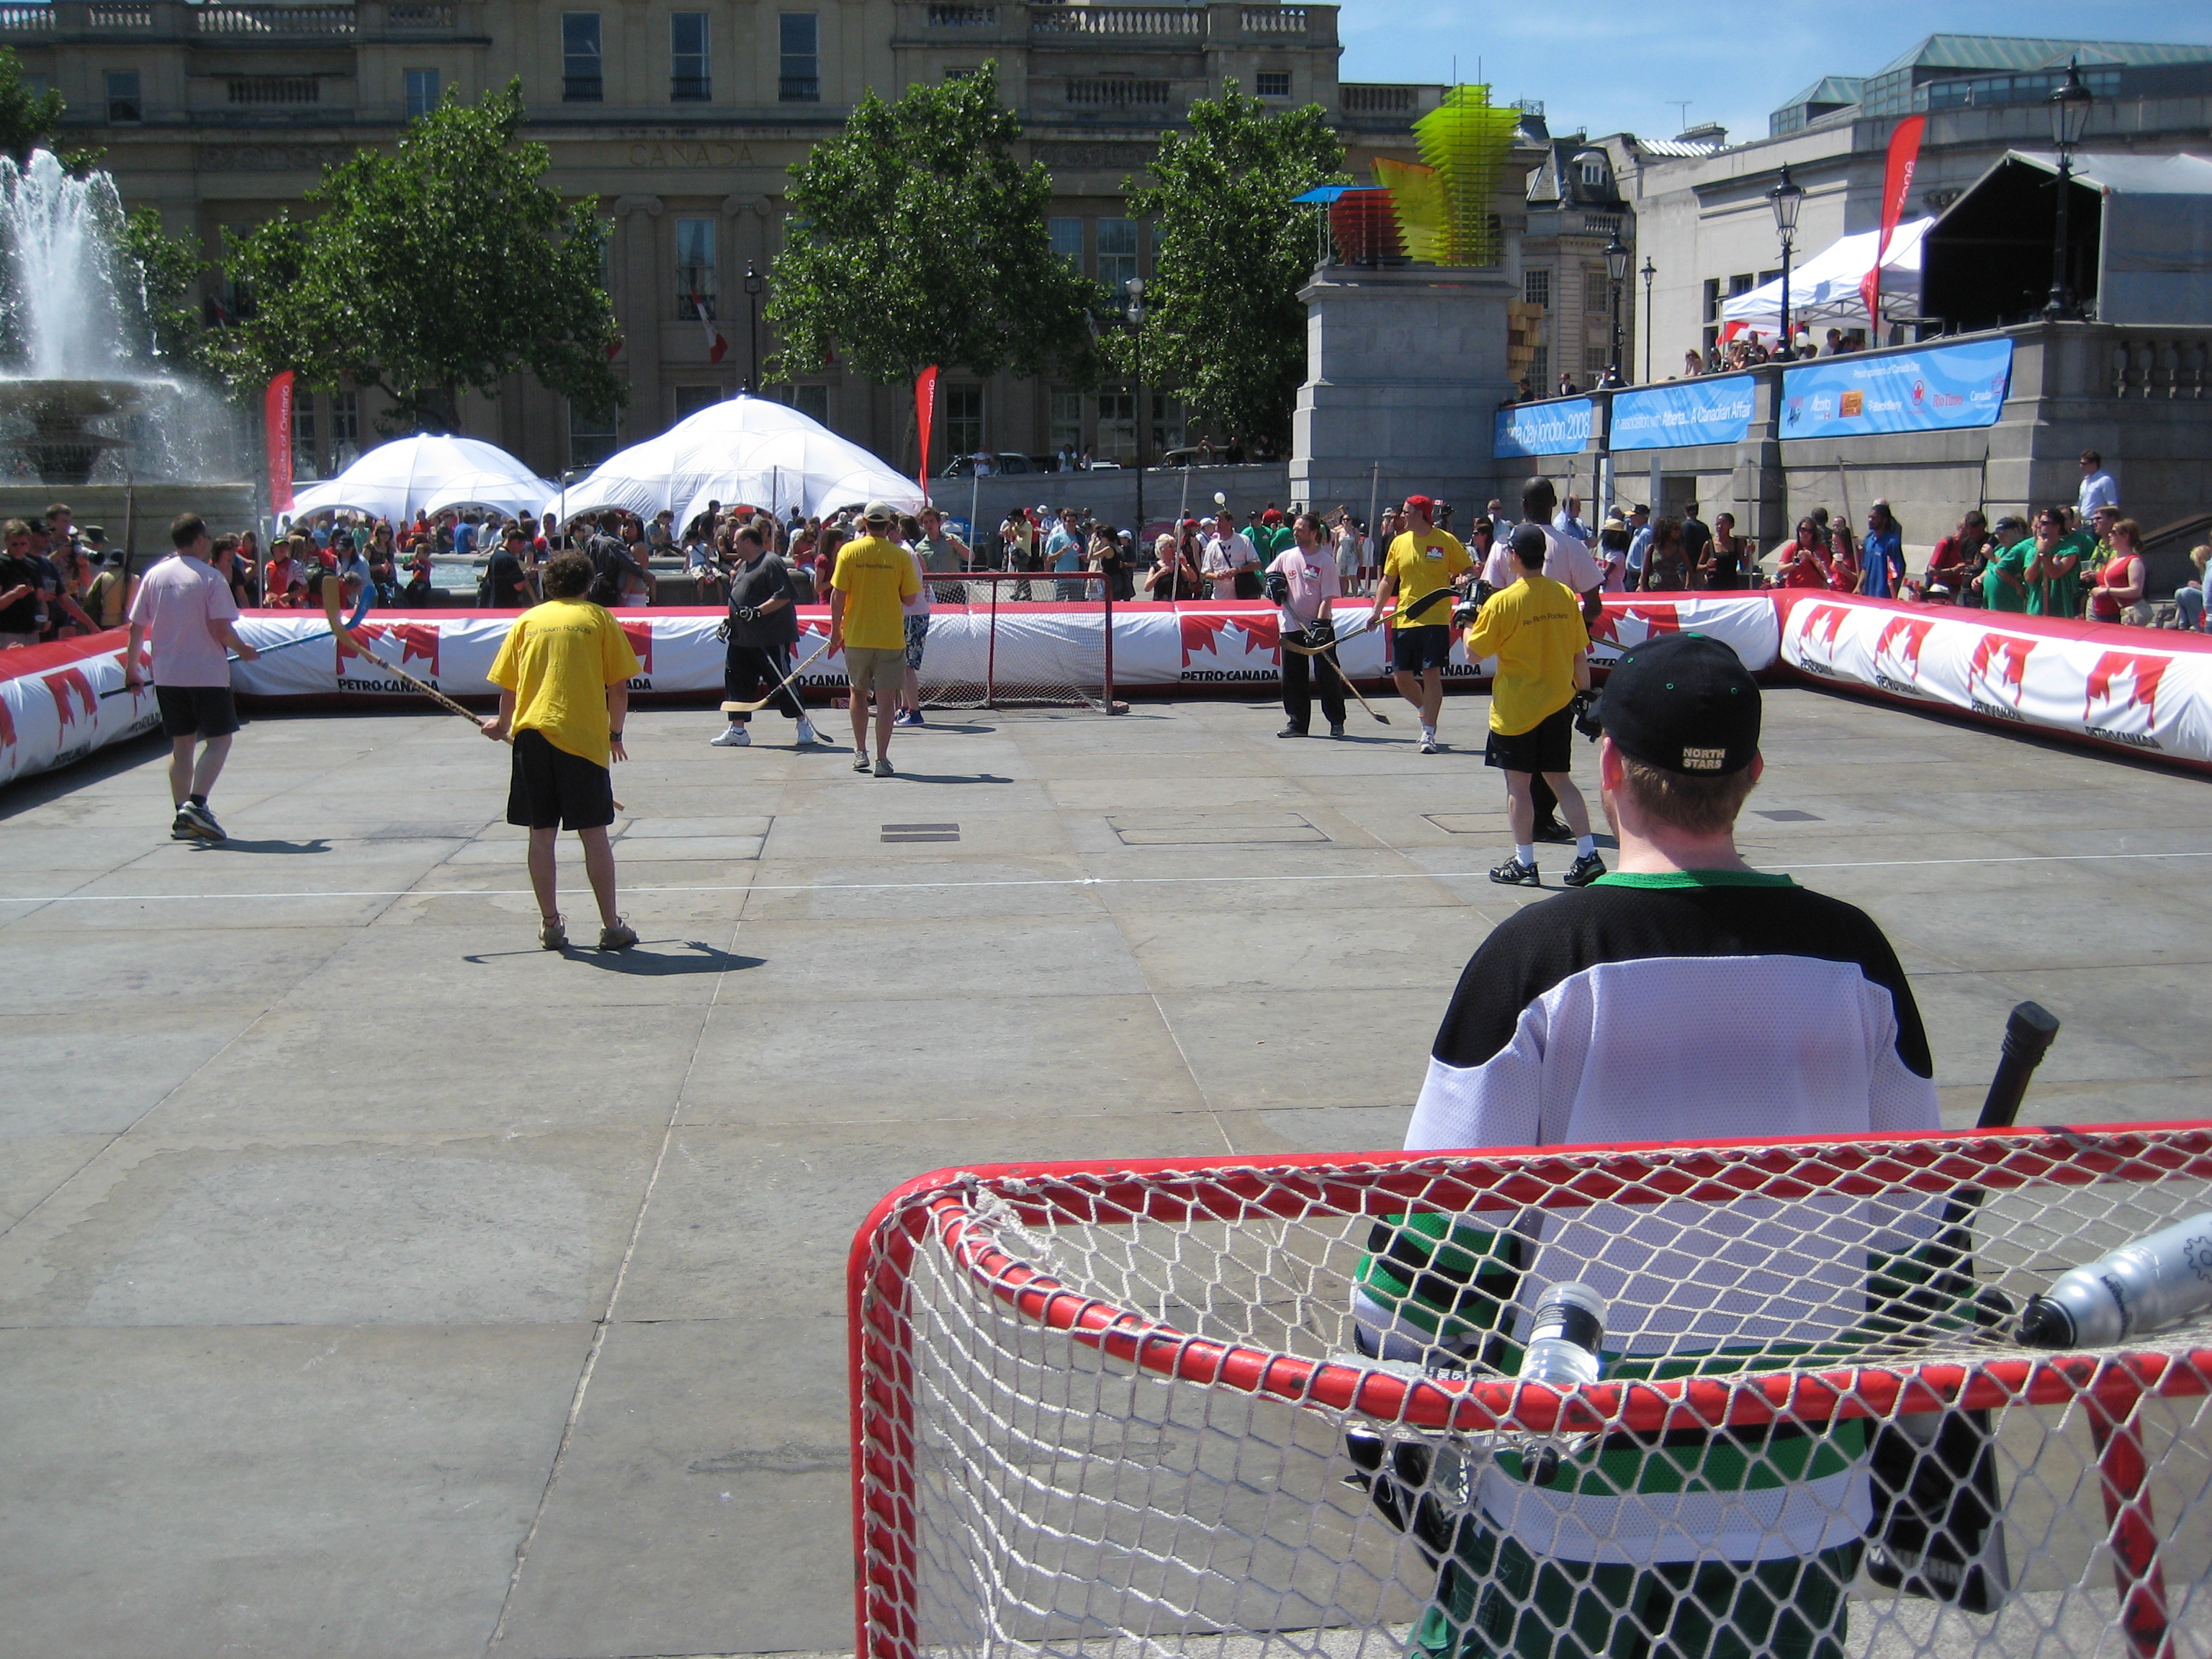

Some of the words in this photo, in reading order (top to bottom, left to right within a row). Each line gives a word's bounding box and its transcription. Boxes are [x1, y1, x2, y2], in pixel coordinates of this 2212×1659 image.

[629, 144, 755, 167] CANADA
[1853, 369, 1866, 378] Proud
[1866, 367, 1886, 378] sponsors
[1892, 364, 1910, 374] Canada
[1910, 361, 1920, 373] Day
[1970, 390, 1992, 401] Canada
[280, 385, 290, 431] Ontario
[1614, 415, 1620, 431] in
[1621, 415, 1650, 430] association
[1690, 407, 1696, 424] A
[1697, 403, 1730, 423] Canadian
[1730, 400, 1752, 418] Affair
[1523, 420, 1537, 449] day
[1539, 416, 1565, 442] london
[1567, 412, 1590, 439] 2008
[281, 434, 288, 447] of
[564, 624, 591, 635] Rockets
[1683, 747, 1725, 759] NORTH
[1683, 758, 1722, 769] STARS
